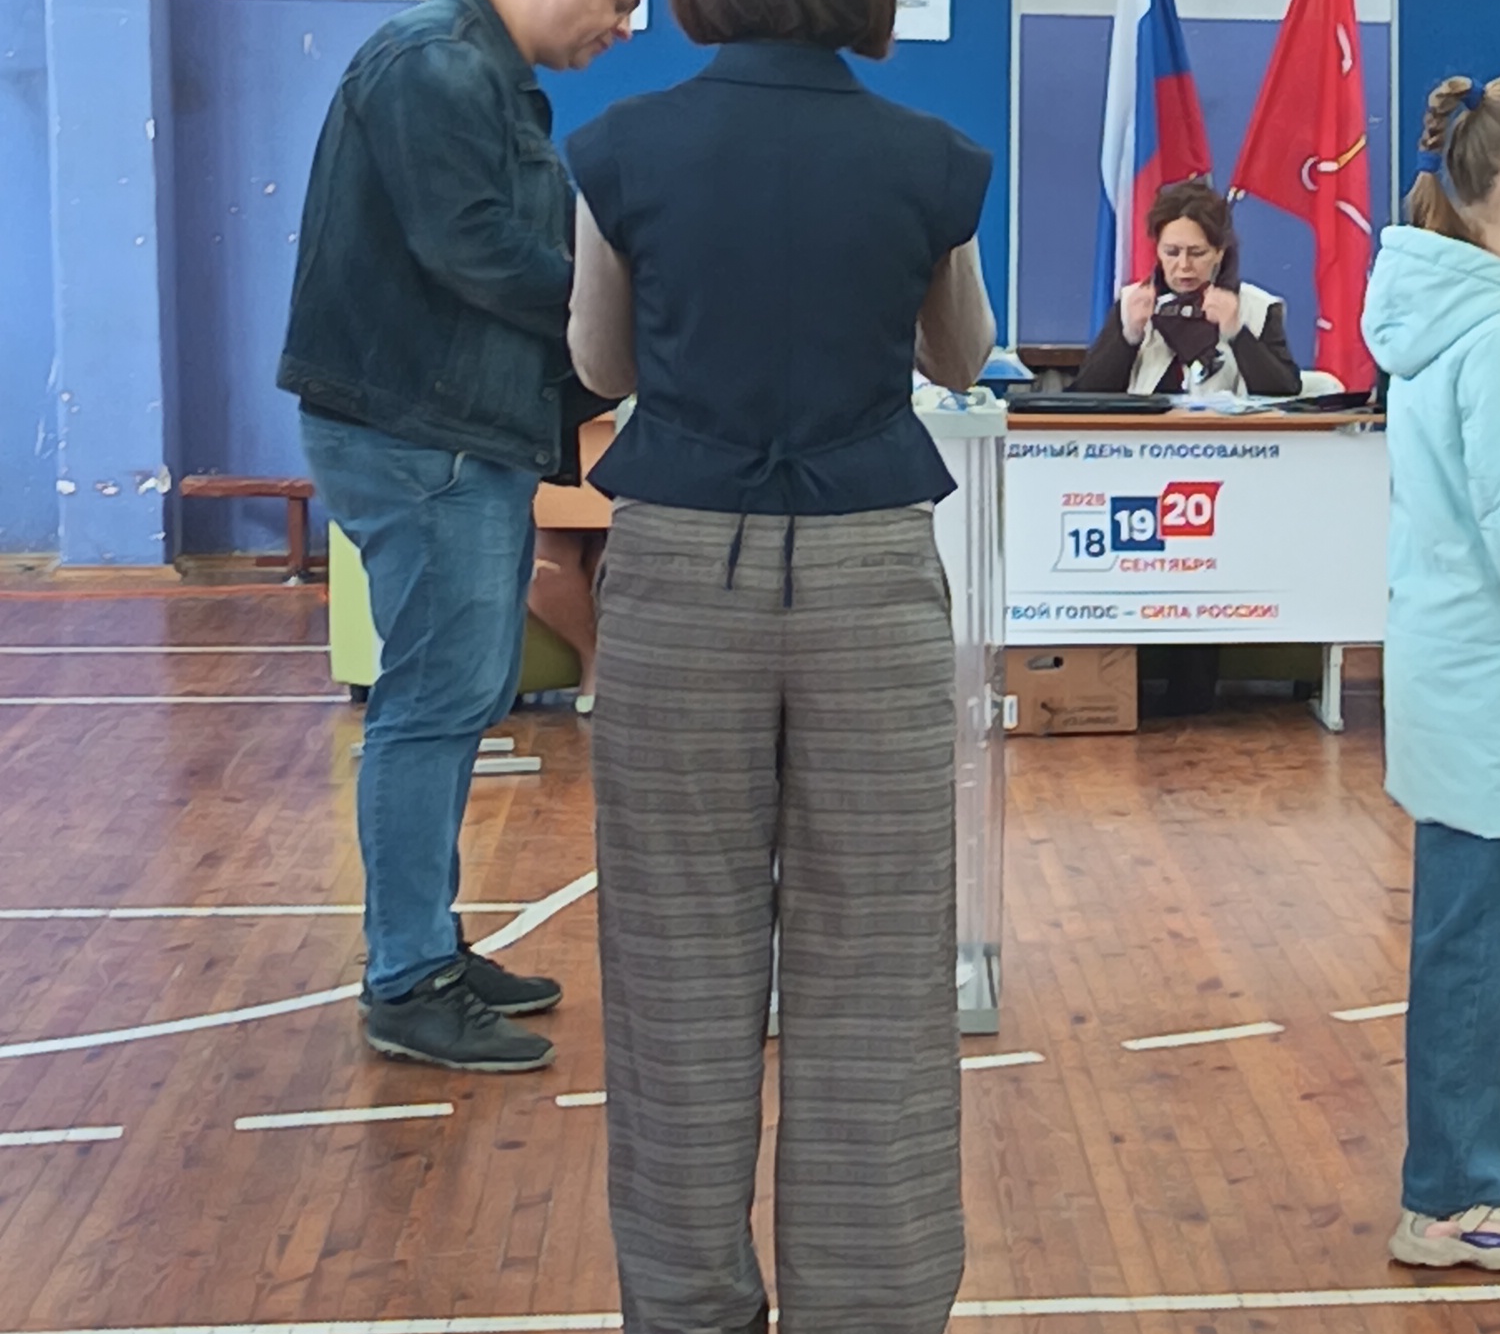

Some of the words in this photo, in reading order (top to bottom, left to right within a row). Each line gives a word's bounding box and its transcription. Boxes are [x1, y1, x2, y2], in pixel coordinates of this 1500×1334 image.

[1004, 440, 1079, 460] ДИНЫЙ
[1084, 444, 1133, 460] ДЕНЬ
[1139, 444, 1280, 459] ГОЛОСОВАНИЯ
[1068, 529, 1106, 558] 18
[1114, 509, 1155, 541] 19
[1163, 493, 1212, 526] 20
[1119, 557, 1217, 573] СЕНТЯБРЯ
[1055, 605, 1119, 620] ГОЛОС
[1140, 604, 1191, 619] СИЛА
[1196, 604, 1279, 619] РОССИИ!
